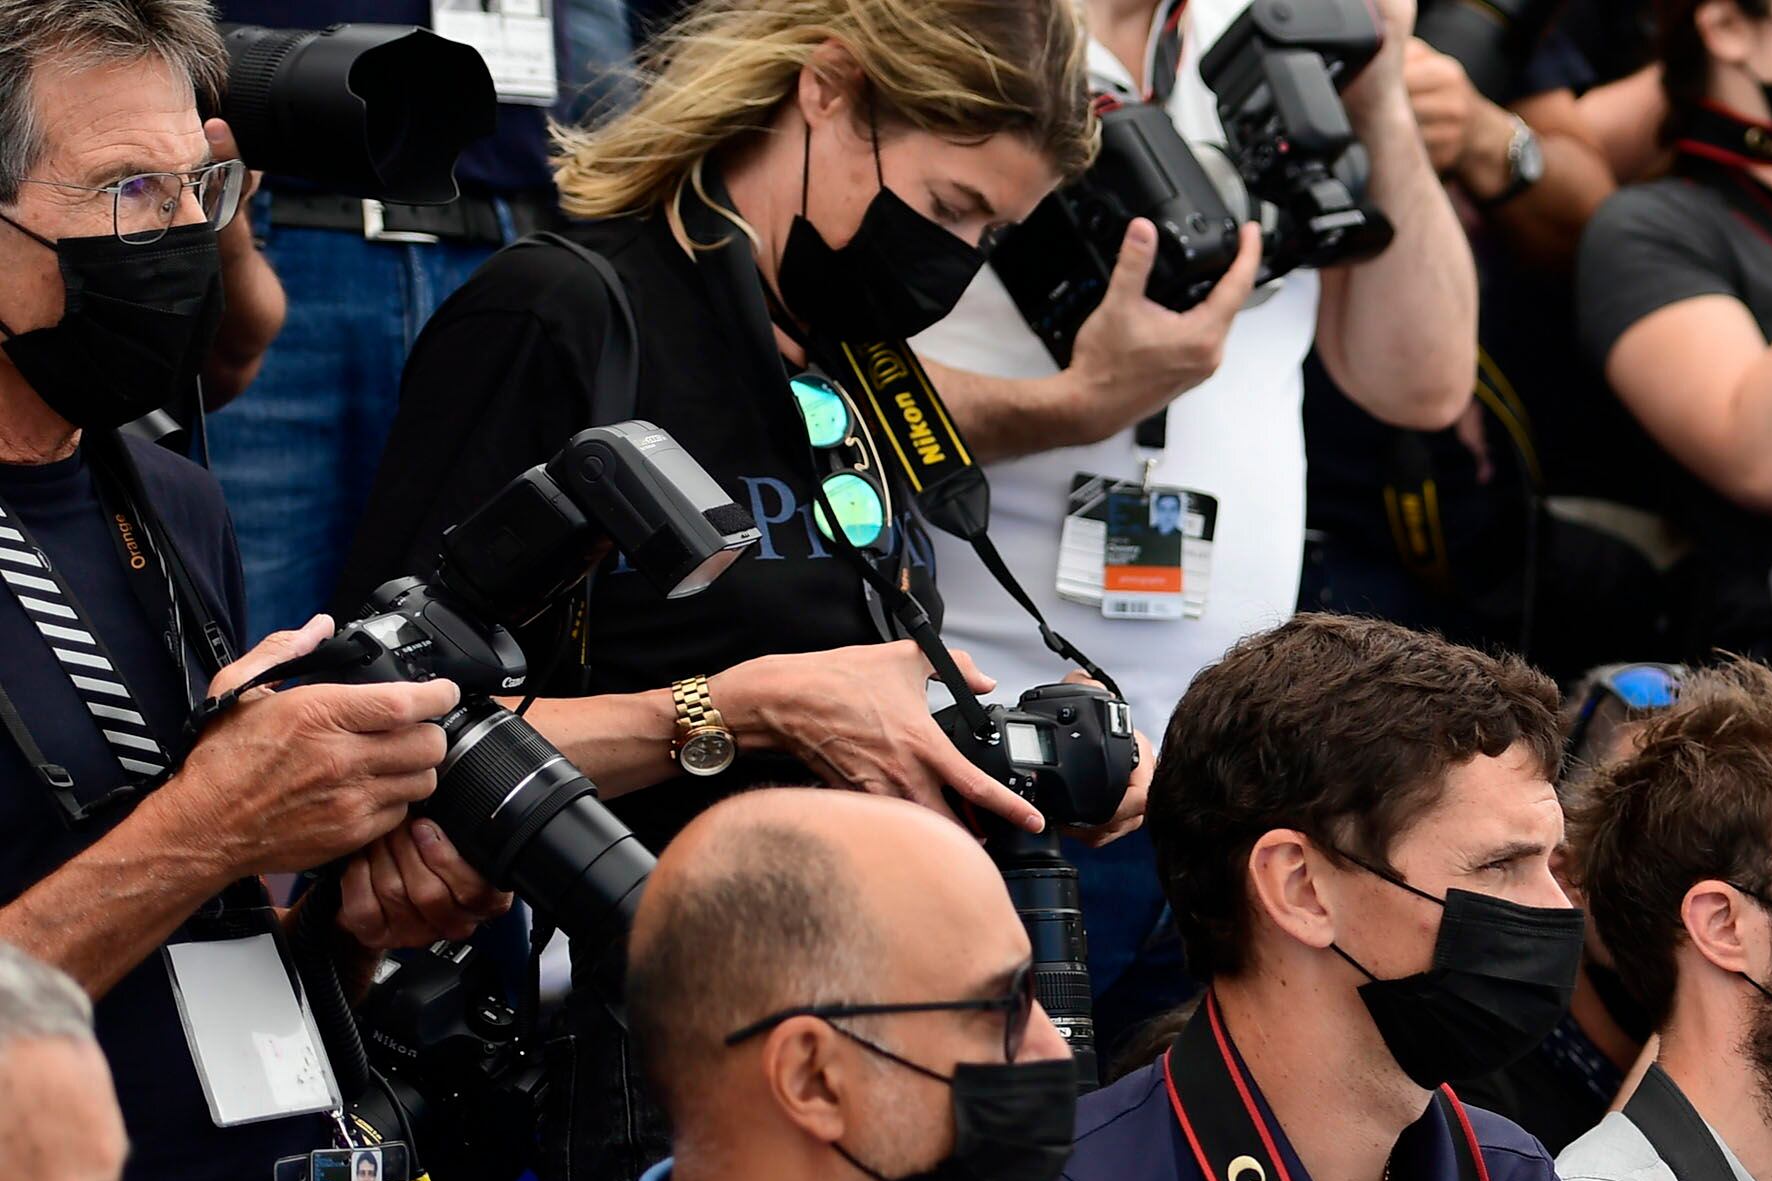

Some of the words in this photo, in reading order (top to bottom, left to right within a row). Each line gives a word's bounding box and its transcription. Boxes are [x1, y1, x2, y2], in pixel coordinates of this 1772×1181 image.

[894, 391, 947, 466] Nikon
[115, 512, 147, 570] Orange
[372, 1028, 419, 1059] Nikon
